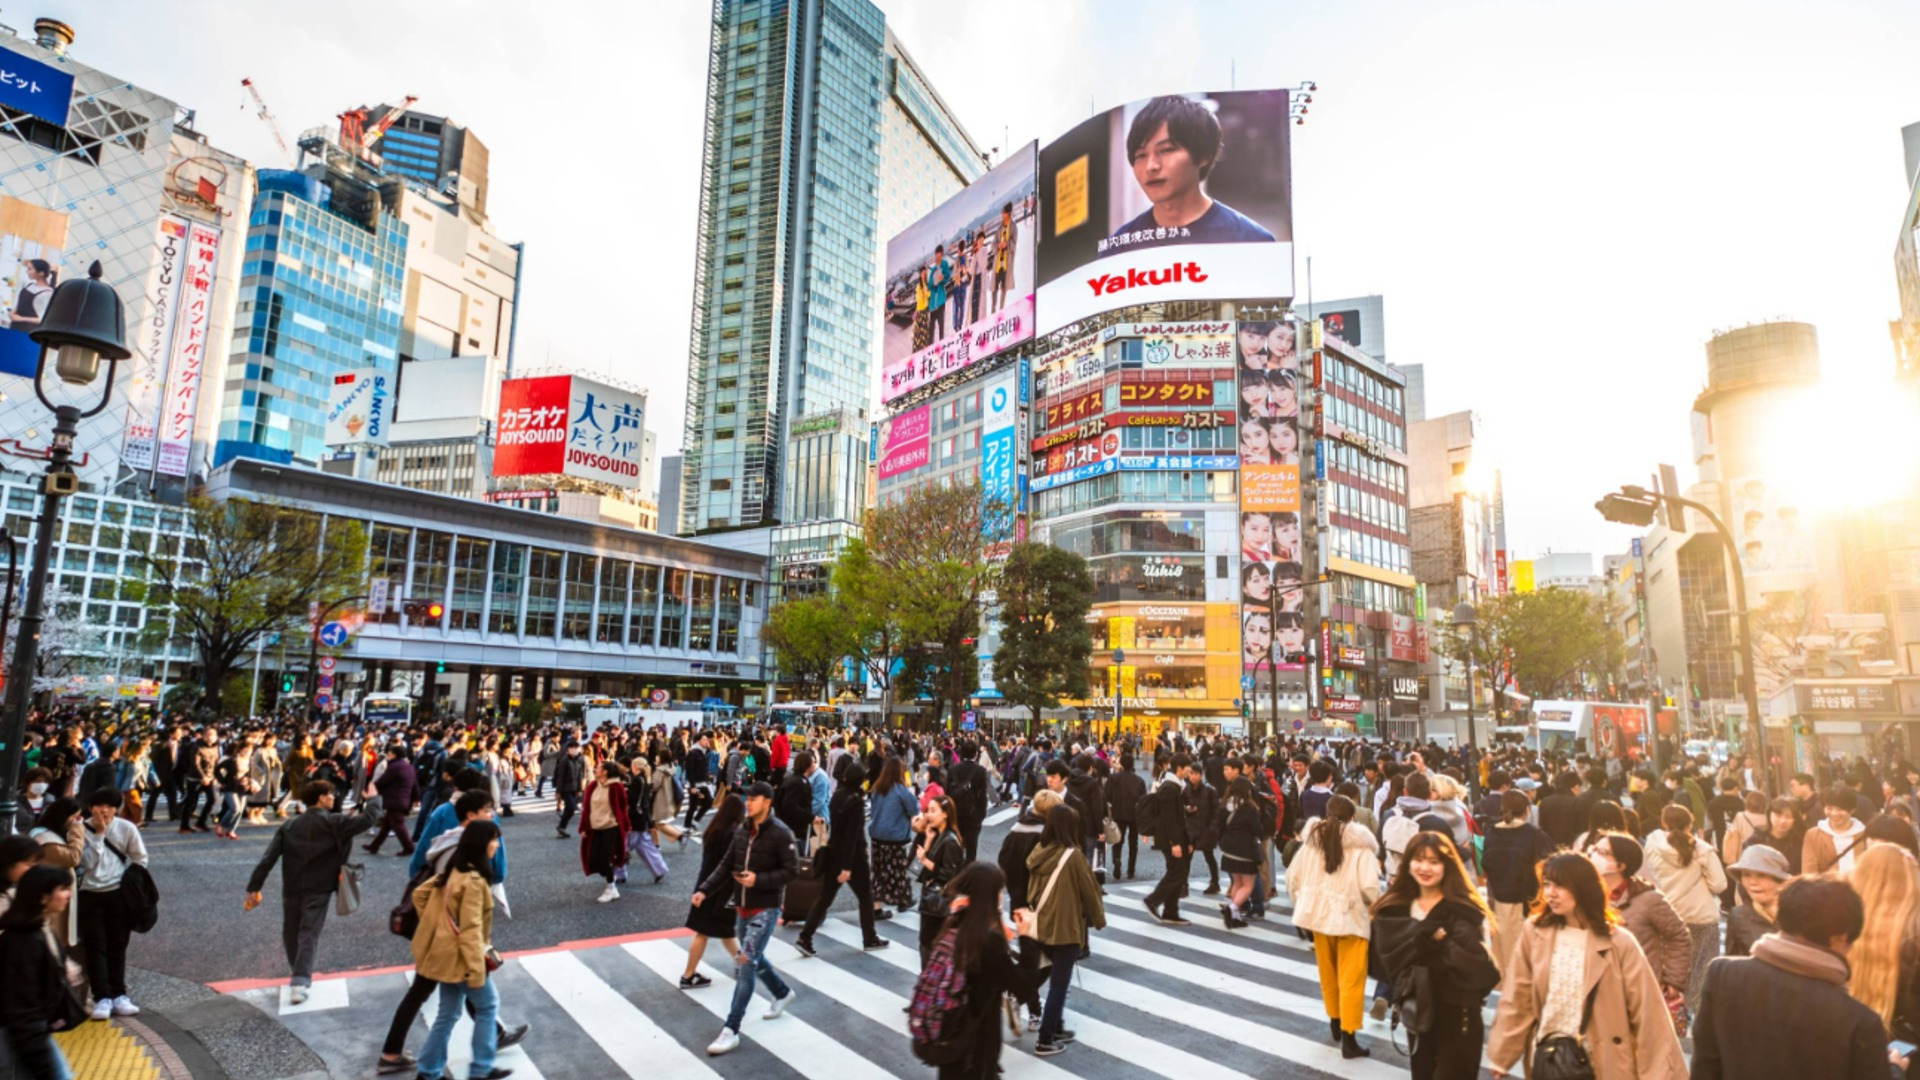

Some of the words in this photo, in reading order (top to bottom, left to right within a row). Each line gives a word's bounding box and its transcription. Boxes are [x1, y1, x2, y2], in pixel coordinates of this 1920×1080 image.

[1087, 262, 1208, 297] Yakult
[1174, 342, 1231, 359] しゃぶ葉
[1121, 384, 1210, 400] コンタクト
[368, 376, 387, 437] SANKYO
[501, 405, 566, 429] カラオケ
[573, 392, 643, 433] 大声
[1079, 418, 1107, 439] ガスト
[1183, 412, 1226, 428] ガスト
[499, 428, 565, 445] JOYSOUND
[567, 448, 639, 477] JOYSOUND
[1064, 443, 1098, 468] ガスト
[1394, 678, 1418, 695] LUSH
